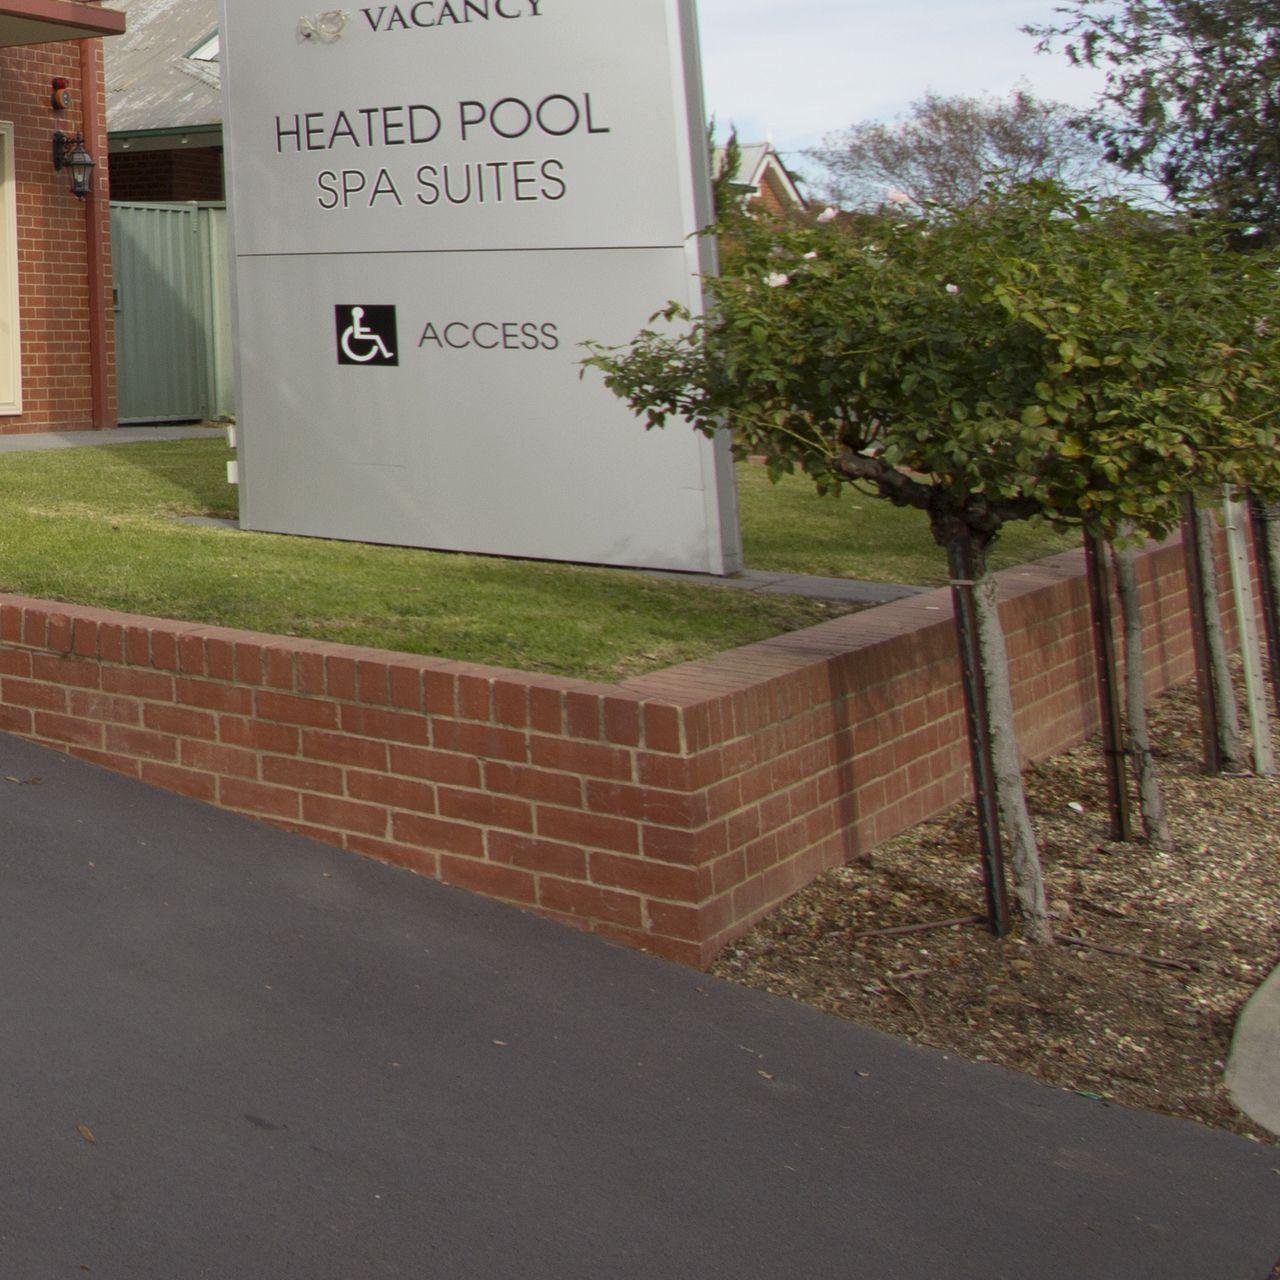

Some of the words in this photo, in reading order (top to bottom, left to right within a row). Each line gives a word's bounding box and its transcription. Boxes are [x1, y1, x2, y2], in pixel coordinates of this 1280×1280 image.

[275, 104, 441, 152] HEATED
[459, 93, 610, 140] POOL
[317, 169, 402, 209] SPA
[416, 159, 566, 205] SUITES
[418, 322, 559, 351] ACCESS
